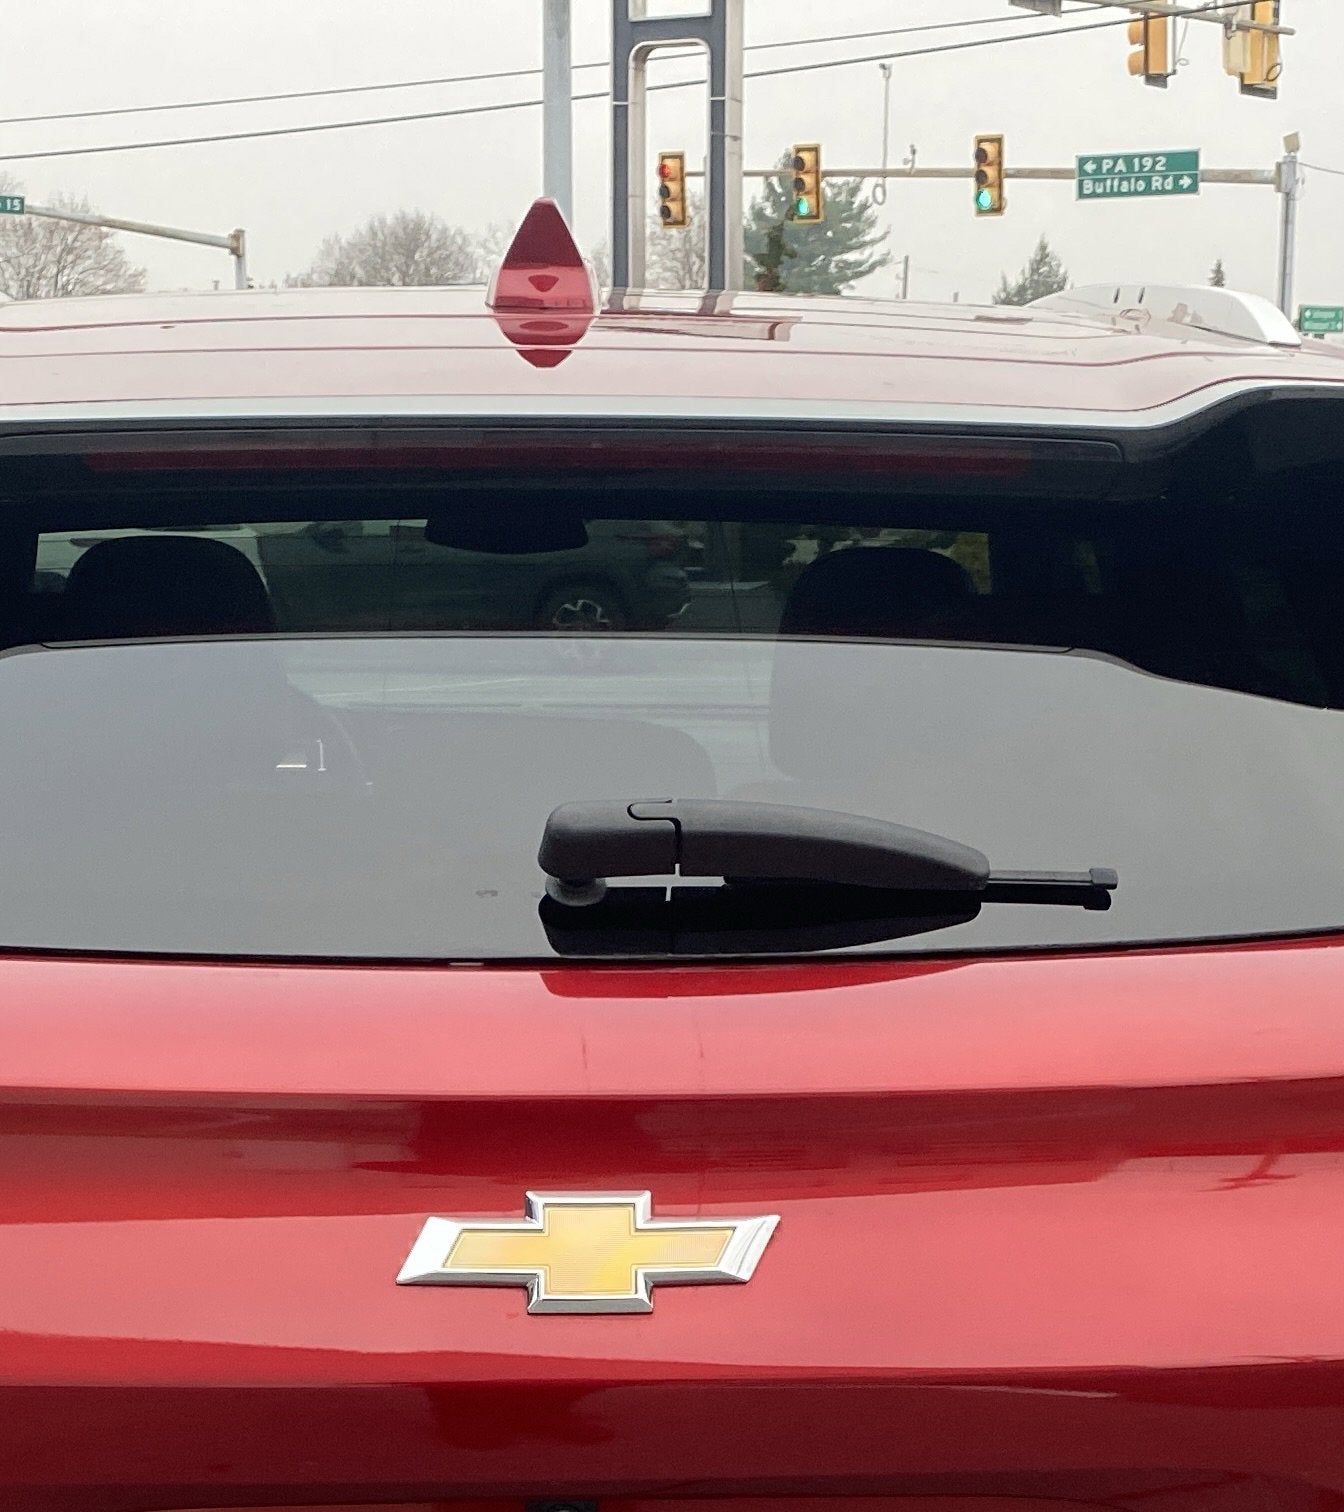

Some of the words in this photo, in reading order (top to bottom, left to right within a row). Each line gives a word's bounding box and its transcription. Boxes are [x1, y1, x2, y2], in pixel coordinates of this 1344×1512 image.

[1101, 158, 1127, 174] PA
[1132, 156, 1167, 172] 192
[1082, 177, 1146, 195] Buffalo
[1151, 175, 1174, 191] Rd
[6, 198, 21, 211] 15
